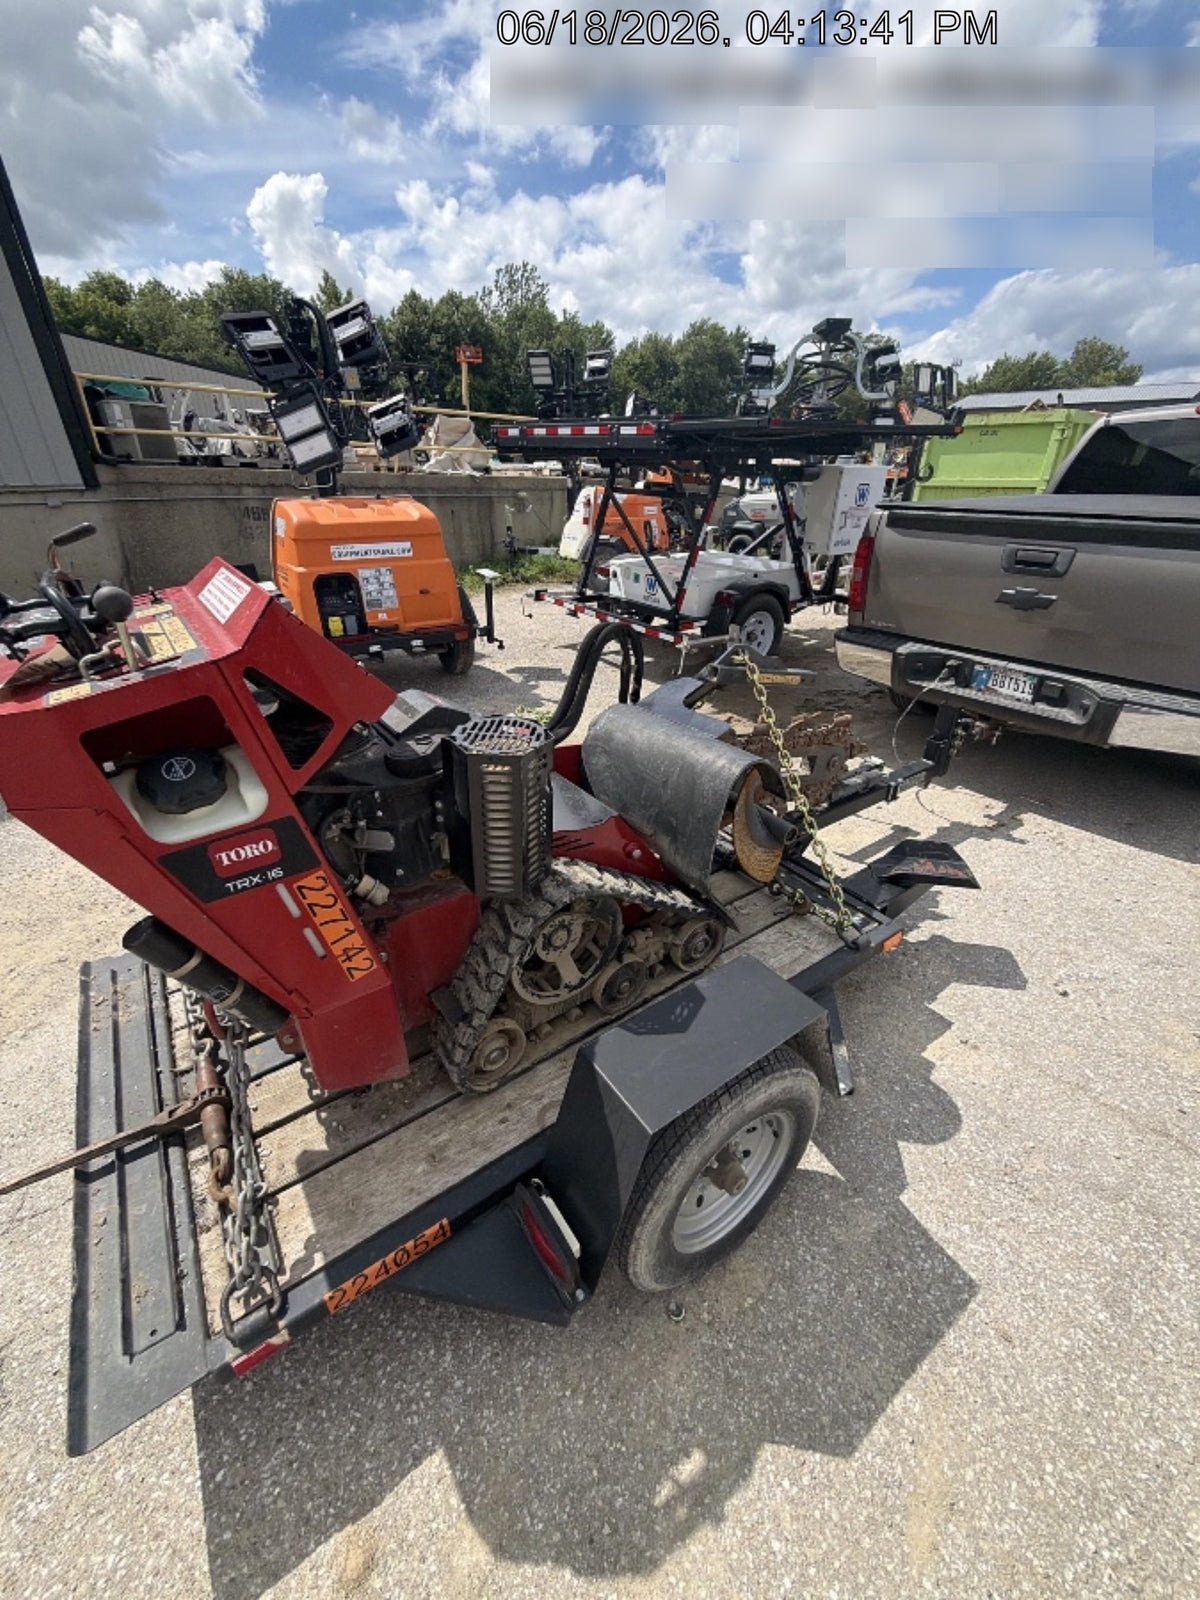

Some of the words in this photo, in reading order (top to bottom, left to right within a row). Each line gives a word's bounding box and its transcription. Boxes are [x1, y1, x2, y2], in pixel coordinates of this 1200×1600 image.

[216, 840, 273, 867] TORO
[296, 875, 375, 980] 227142
[328, 1221, 449, 1310] 224054
